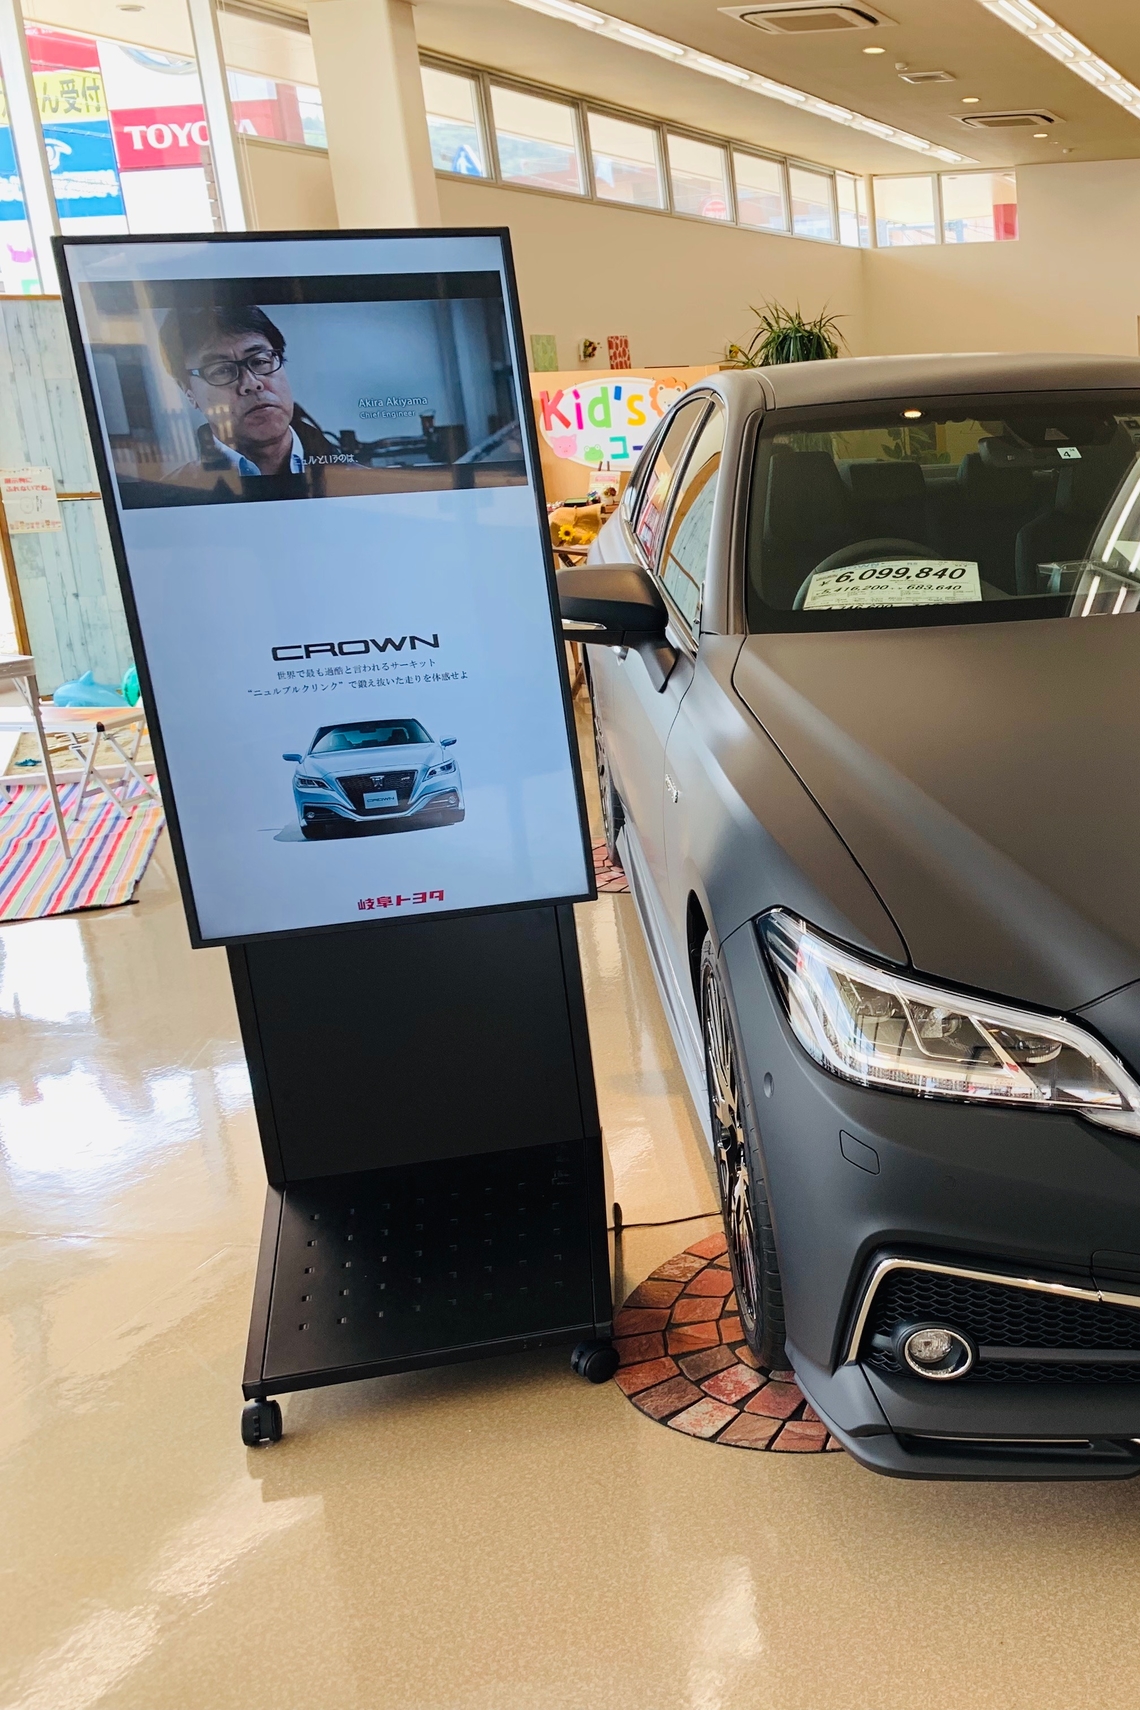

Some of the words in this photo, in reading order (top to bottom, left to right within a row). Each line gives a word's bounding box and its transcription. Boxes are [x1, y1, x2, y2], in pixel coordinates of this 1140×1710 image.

[123, 119, 259, 150] TOYOA
[359, 399, 384, 408] Akira
[386, 396, 428, 408] Akiyama
[540, 386, 646, 431] Kid's
[360, 411, 380, 419] Chief
[382, 410, 416, 419] Engineer
[835, 567, 967, 583] 6,099,840
[271, 633, 440, 662] CROWN
[277, 658, 436, 680] 世界で最も過酷と言われるサーキット
[357, 889, 445, 911] 岐阜トヨタ
